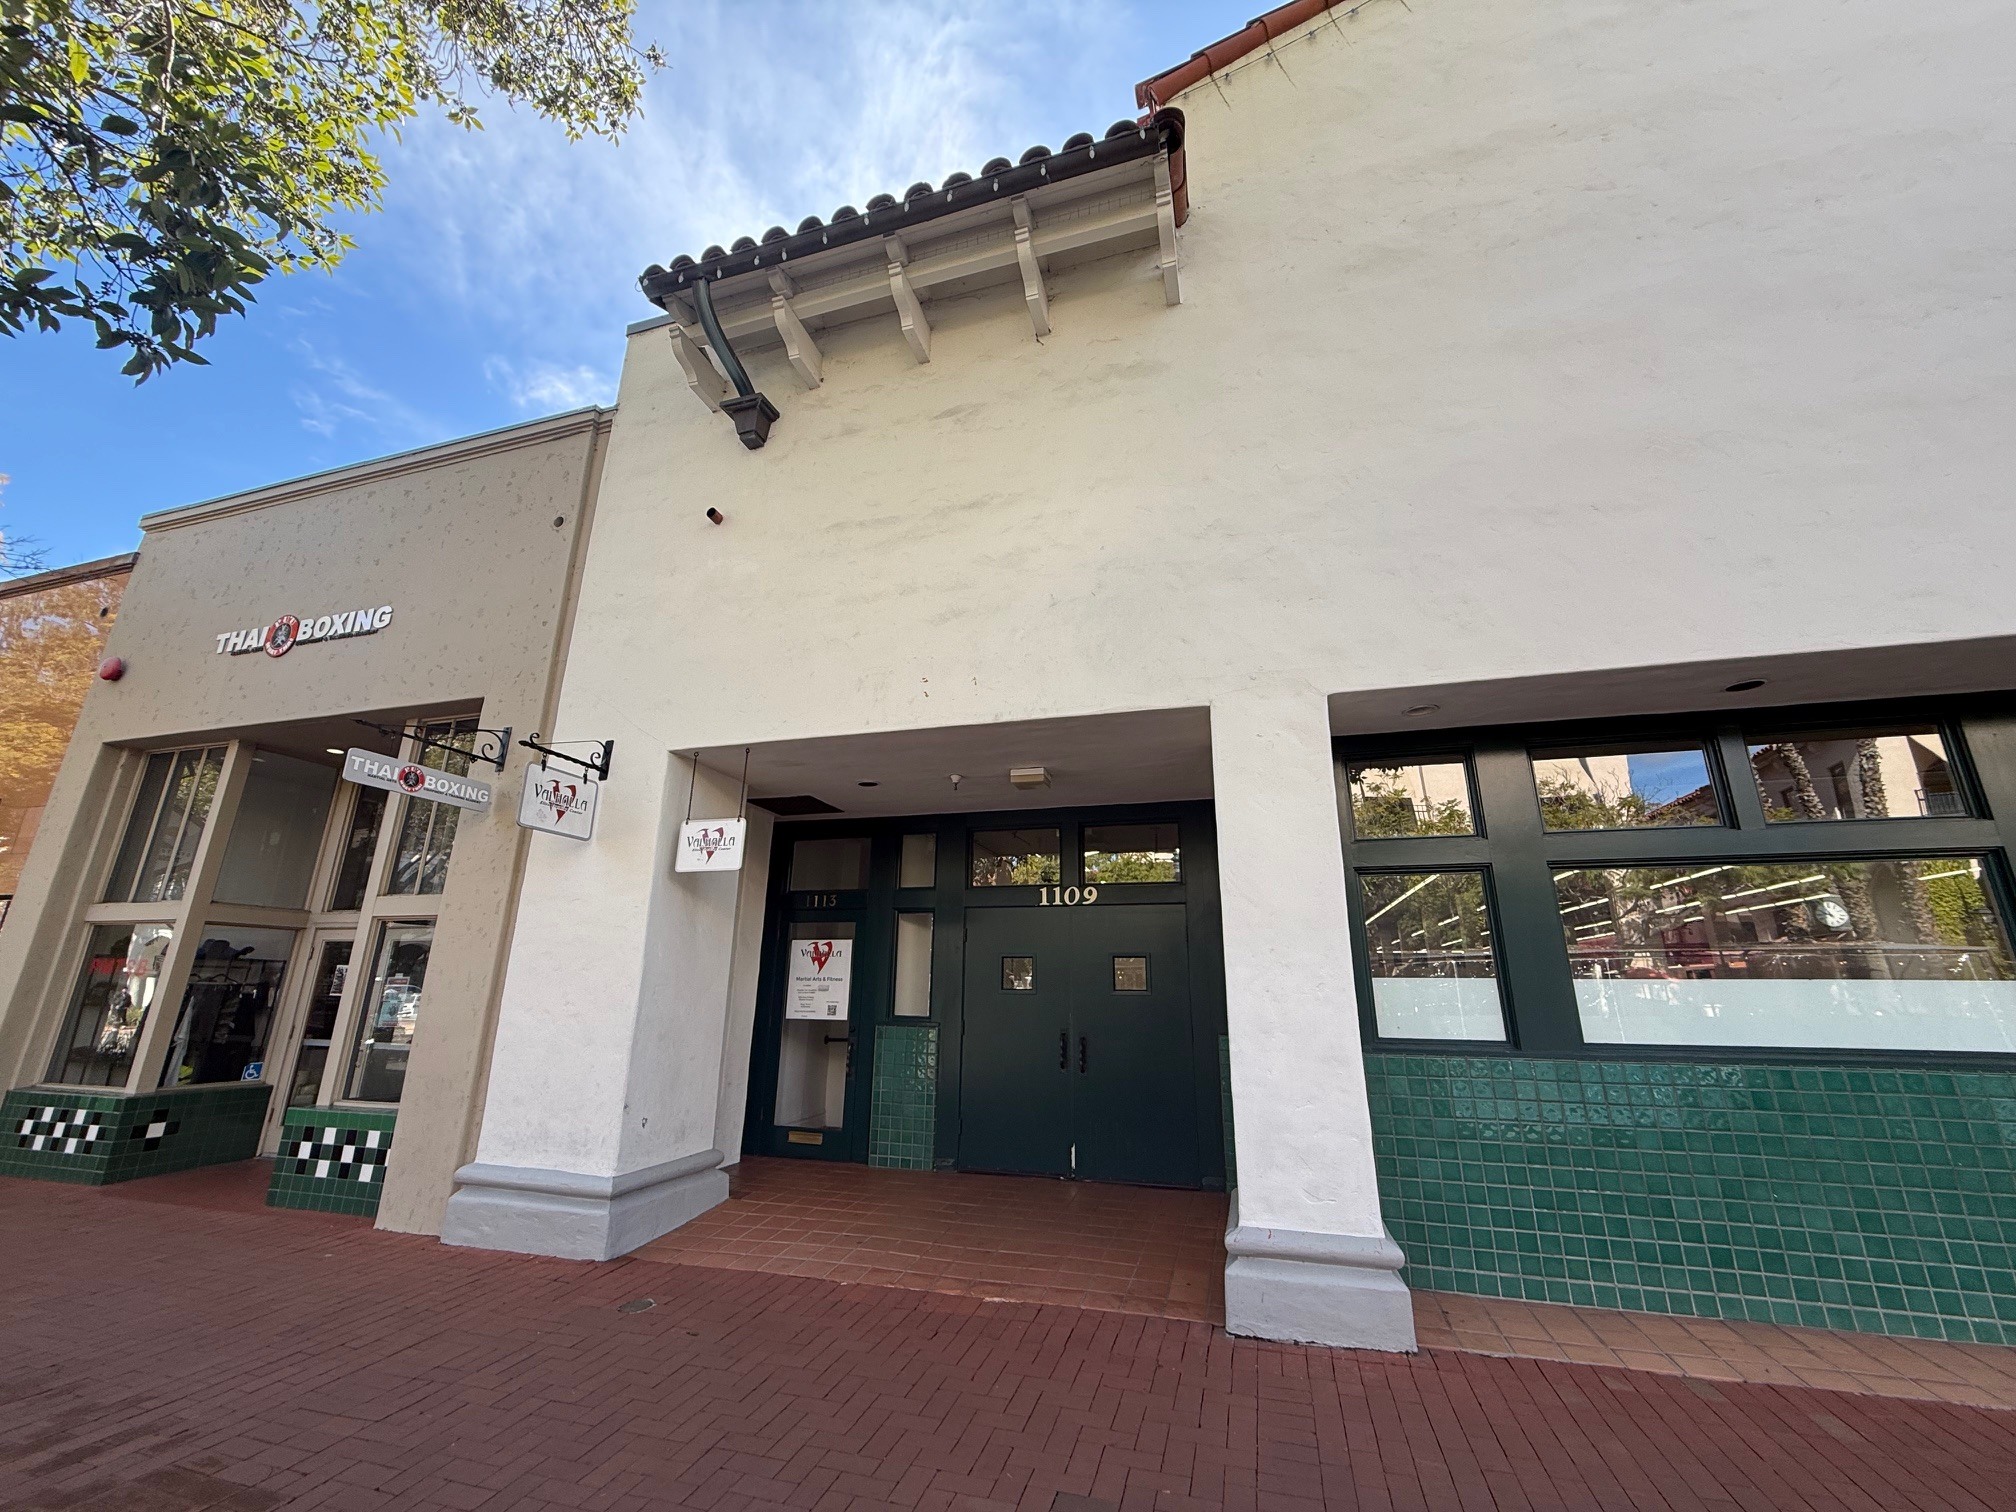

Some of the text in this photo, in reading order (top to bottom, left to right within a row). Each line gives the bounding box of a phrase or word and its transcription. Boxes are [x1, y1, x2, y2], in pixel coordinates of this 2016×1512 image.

[216, 626, 270, 655] THAI
[296, 605, 393, 642] BOXING
[351, 755, 489, 802] THAI BOXING
[535, 783, 588, 811] VALHALLA
[687, 836, 735, 848] VALHALLA
[806, 895, 837, 907] 1113
[1039, 886, 1098, 906] 1109
